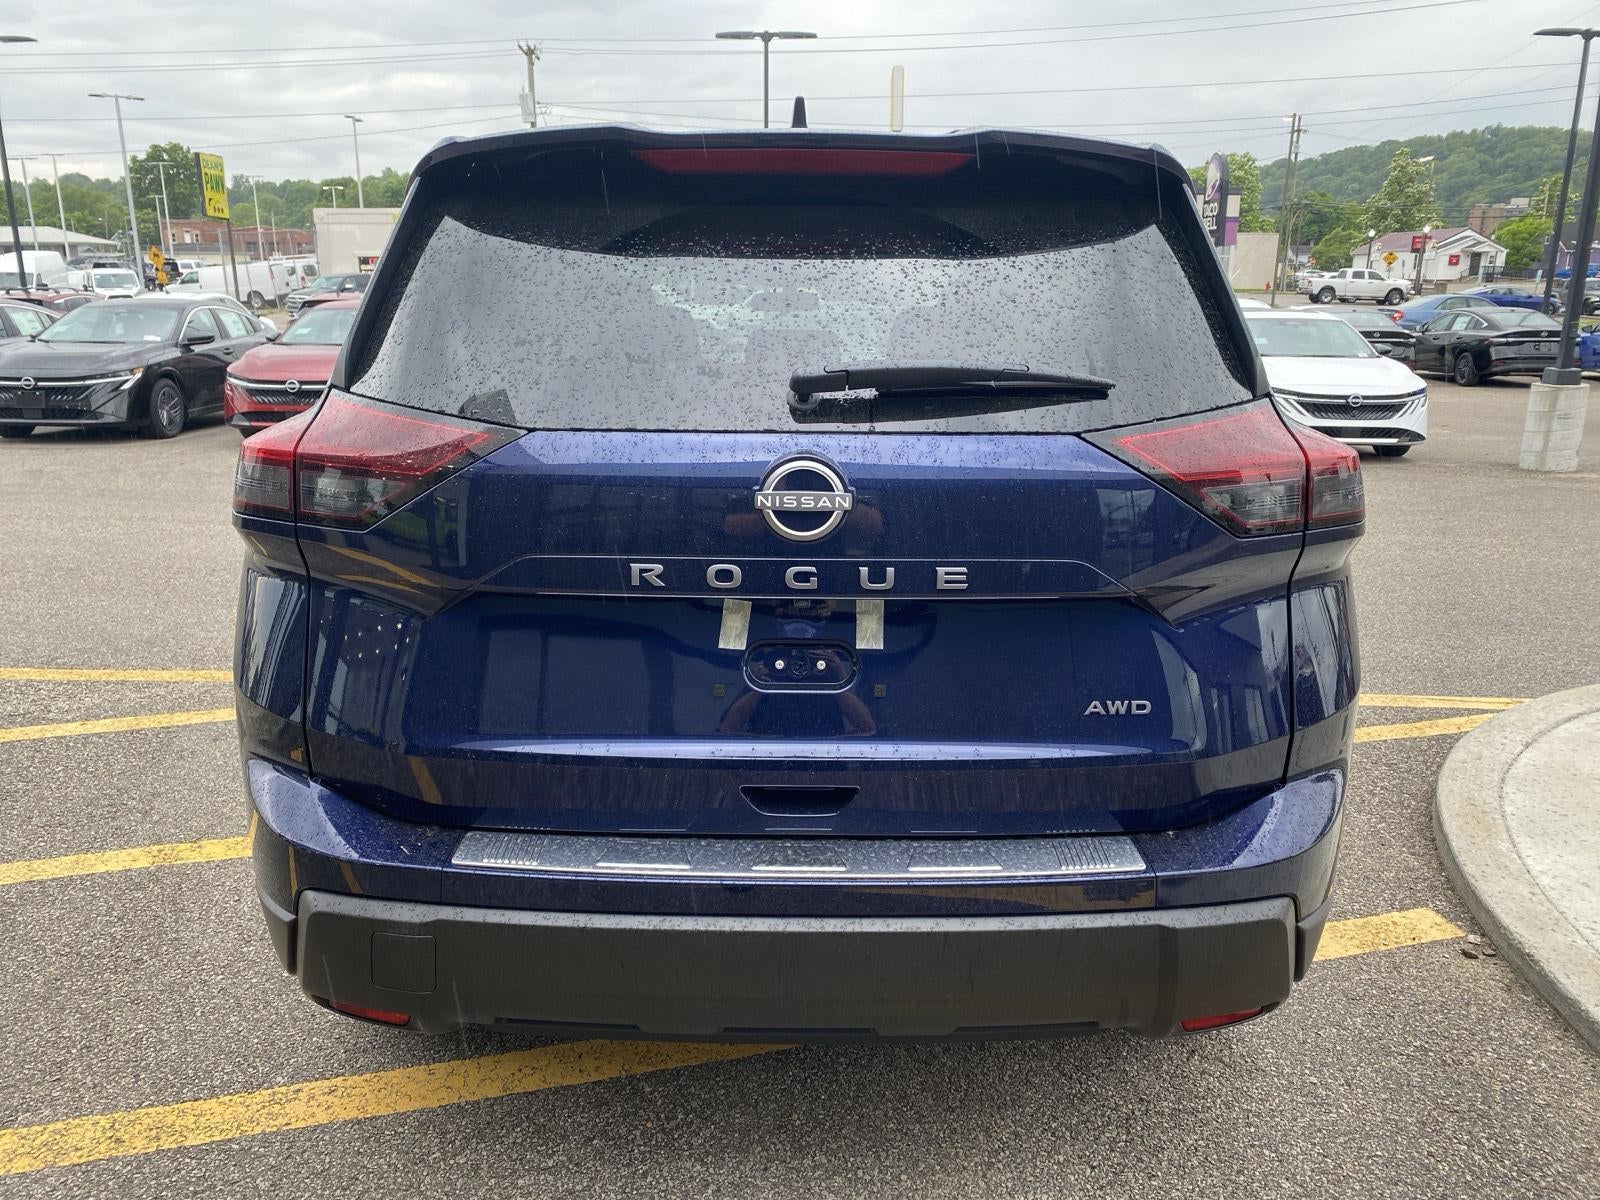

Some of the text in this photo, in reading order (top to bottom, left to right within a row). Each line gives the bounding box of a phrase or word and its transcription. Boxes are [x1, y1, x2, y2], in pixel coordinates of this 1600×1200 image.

[1203, 203, 1218, 217] TACO
[757, 495, 849, 508] NISSAN
[630, 563, 969, 591] ROGUE
[1083, 699, 1152, 716] AWD
